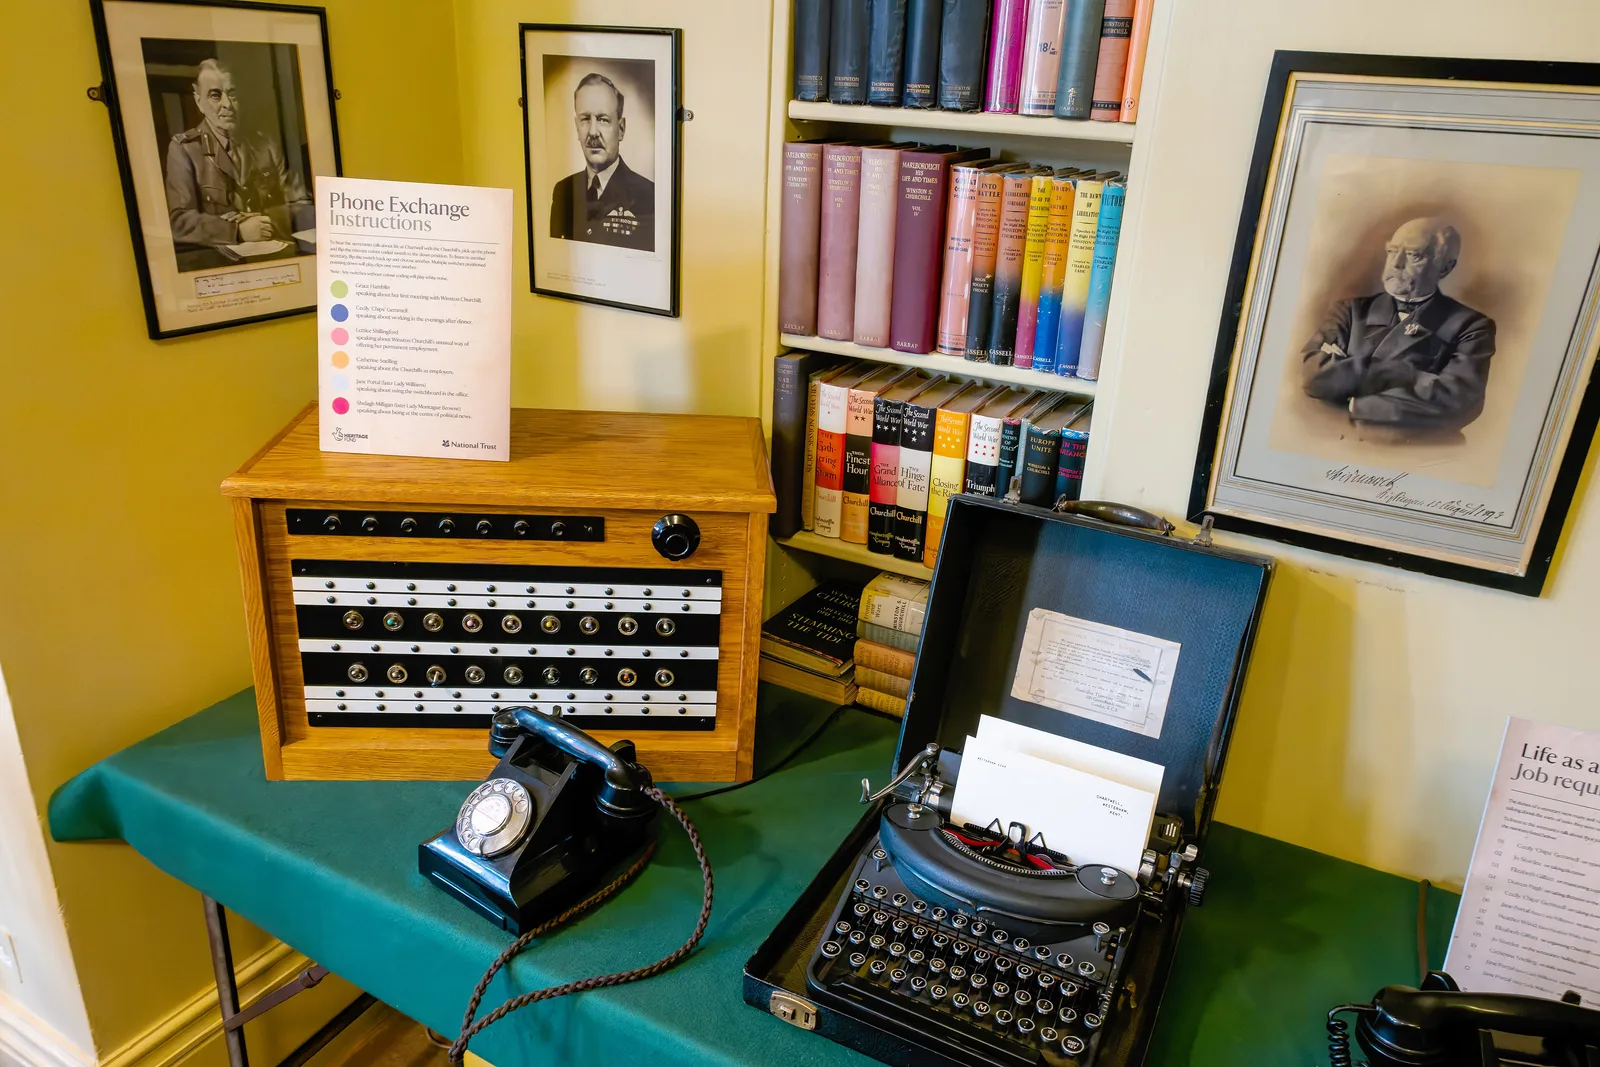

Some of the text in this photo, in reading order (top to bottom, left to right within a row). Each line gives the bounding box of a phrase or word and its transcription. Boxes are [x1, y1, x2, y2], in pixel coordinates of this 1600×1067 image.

[902, 162, 940, 171] MARLBOROUGH
[329, 192, 470, 221] Phone Exchange
[329, 210, 433, 232] Instructions
[896, 341, 919, 349] HARRAP
[988, 348, 1013, 357] CASSELL
[848, 394, 859, 405] The
[848, 405, 861, 414] World
[875, 402, 902, 414] The Second
[903, 406, 930, 419] The Second
[875, 414, 902, 424] World War
[903, 418, 930, 429] World War
[972, 421, 1000, 433] The Second
[972, 432, 999, 443] World War
[1030, 436, 1056, 446] EUROPE
[451, 441, 497, 451] National Trust
[1031, 444, 1052, 454] UNITE
[845, 451, 871, 465] Finest
[816, 467, 837, 480] Storm
[846, 462, 869, 475] Hour
[873, 464, 897, 476] Grand
[900, 467, 925, 482] Hinge
[872, 475, 898, 487] Alliance
[898, 477, 926, 493] of Fate
[932, 477, 960, 491] Closing
[966, 478, 995, 493] Triumph
[931, 486, 942, 497] the
[842, 495, 869, 507] Churchill
[869, 506, 896, 518] Churchill
[896, 511, 923, 525] Churchill
[864, 594, 872, 620] Frontiers
[787, 619, 846, 645] THE TIDE
[1520, 742, 1599, 774] Life as a
[1510, 763, 1600, 796] Job requ
[1066, 1039, 1080, 1047] SHIFT
